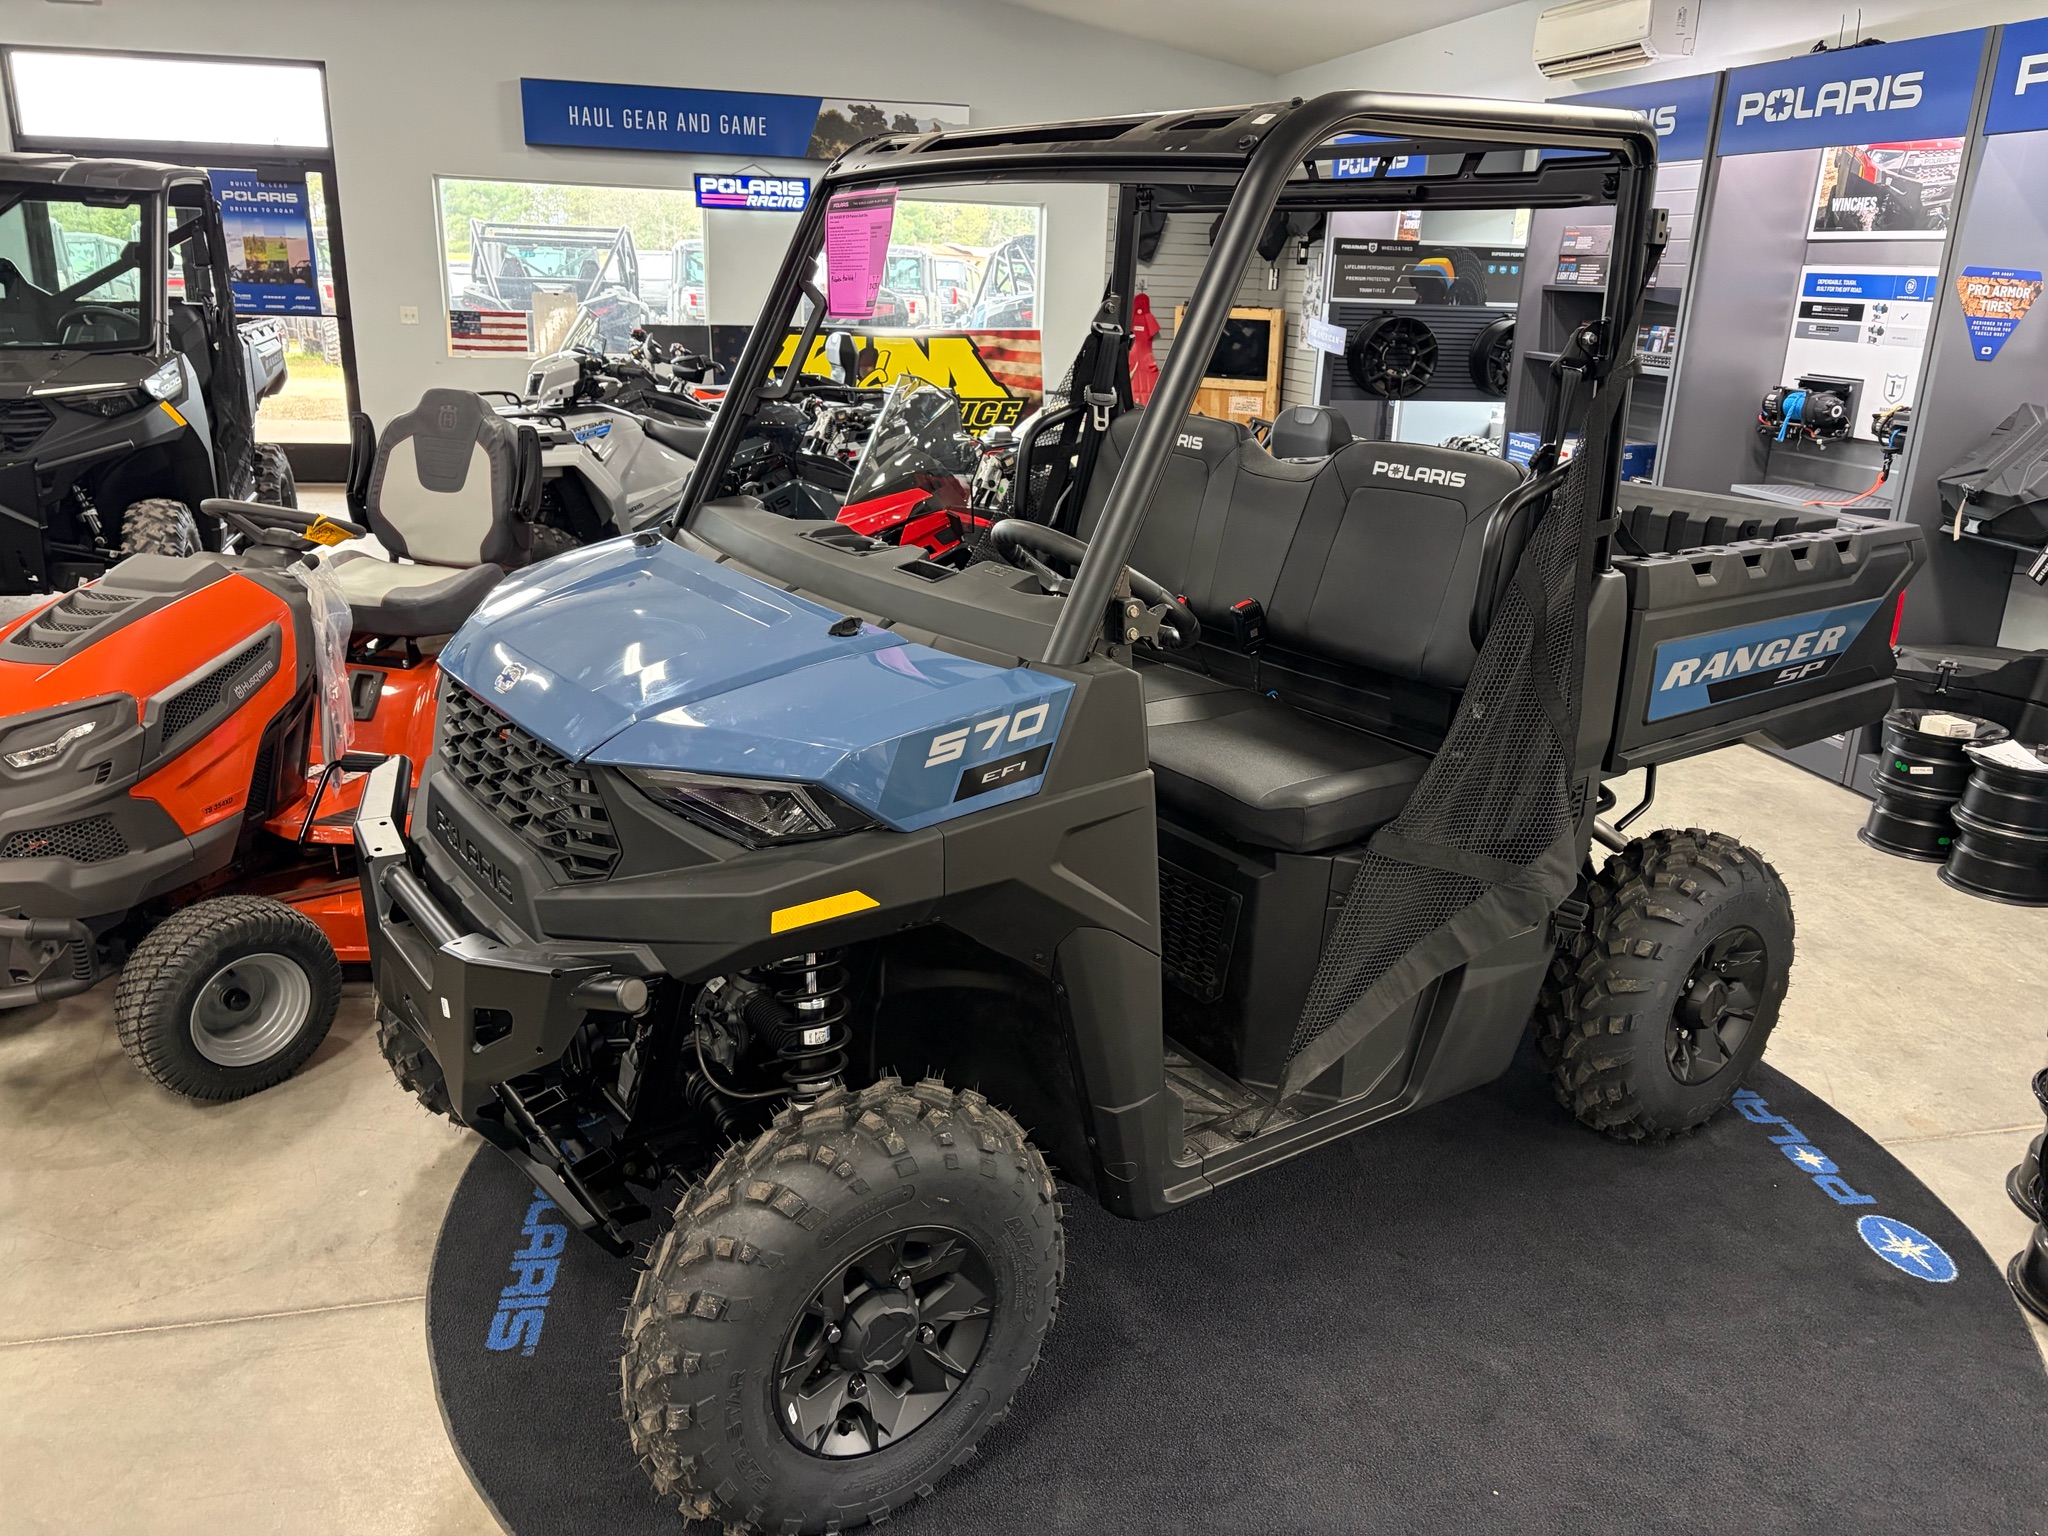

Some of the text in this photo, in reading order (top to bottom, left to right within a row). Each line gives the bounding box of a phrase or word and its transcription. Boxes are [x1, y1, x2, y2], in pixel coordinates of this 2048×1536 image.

[1736, 71, 1925, 126] POLARIS
[568, 105, 767, 136] HAUL GEAR AND GAME
[1338, 155, 1409, 176] POLAIS
[221, 190, 299, 204] POLARIS
[700, 178, 805, 197] POLARIS
[746, 195, 805, 209] RACING
[1967, 283, 2031, 299] PRO ARMOR
[1980, 300, 2012, 313] TIRES
[1510, 439, 1535, 451] POLARIS
[1372, 461, 1467, 488] POLARIS
[1660, 625, 1847, 692] RANGER
[242, 660, 274, 693] Husqvarna
[1774, 659, 1826, 684] SP
[924, 703, 1050, 768] 570
[981, 760, 1027, 784] EFI
[204, 797, 234, 815] TS 354XD
